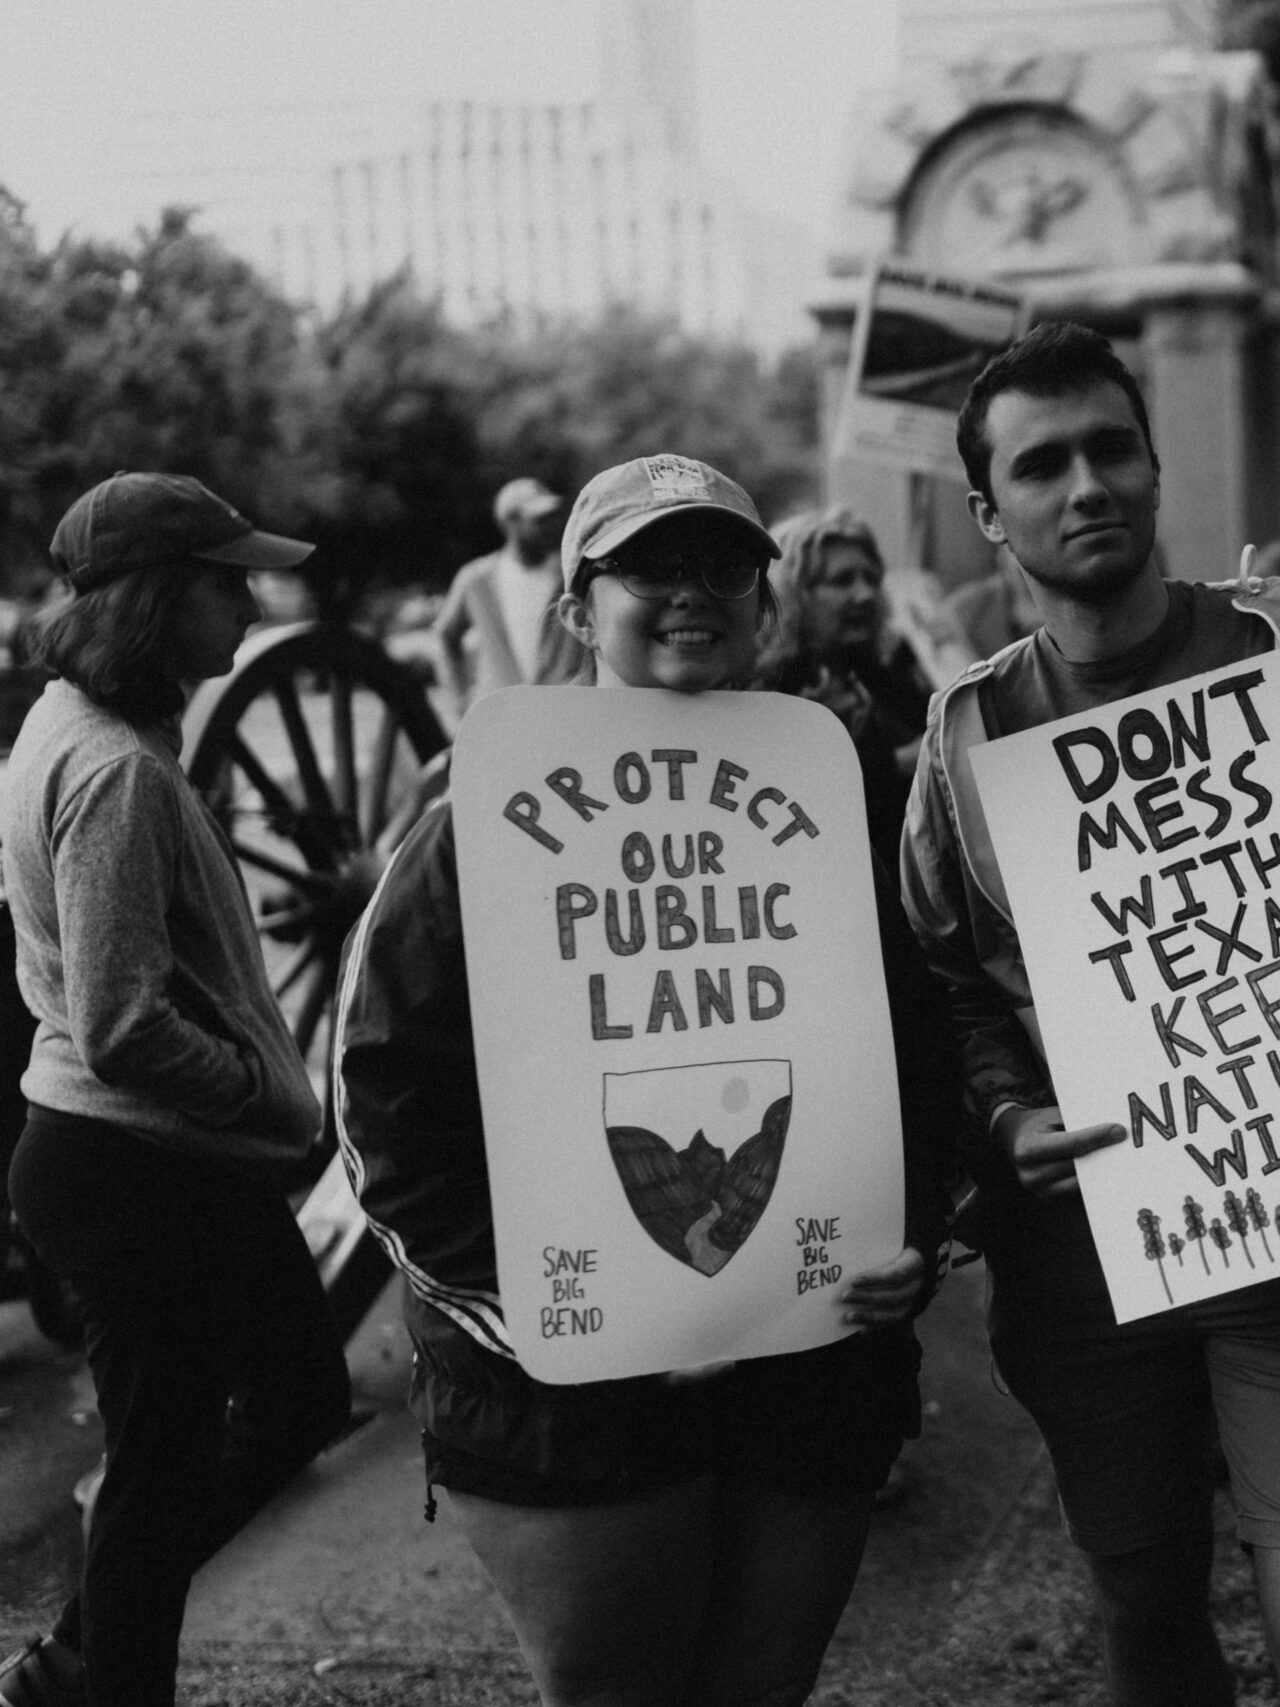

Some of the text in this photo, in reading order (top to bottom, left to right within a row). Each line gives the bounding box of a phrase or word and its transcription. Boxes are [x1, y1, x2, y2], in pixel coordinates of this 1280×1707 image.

[1052, 669, 1270, 804] DONT
[503, 749, 820, 855] PROTECT
[1077, 749, 1273, 872] MESS
[621, 831, 725, 883] OUR
[556, 882, 798, 960] PUBLIC
[589, 965, 786, 1040] LAND
[795, 1217, 842, 1247] SAVE
[542, 1246, 599, 1278] SAVE
[803, 1246, 829, 1266] BIG
[553, 1278, 585, 1303] BIG
[796, 1264, 843, 1296] BEND
[541, 1307, 603, 1339] BEND
